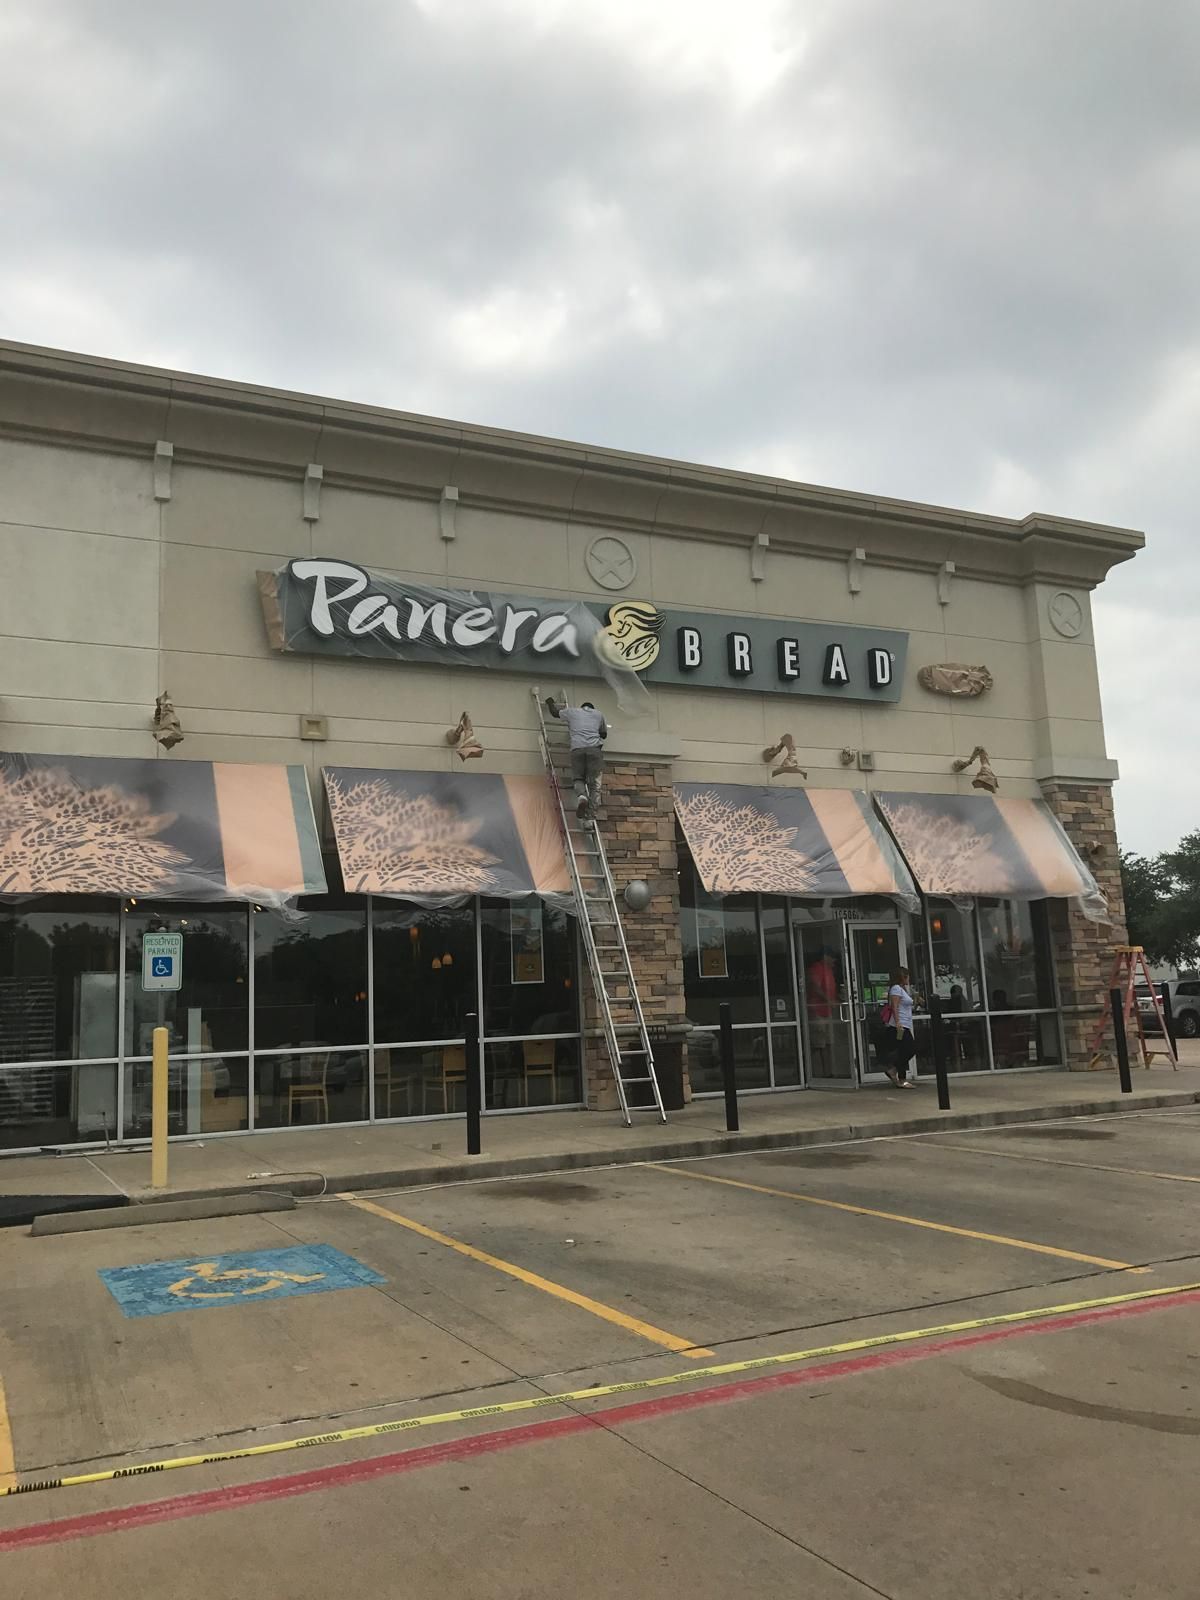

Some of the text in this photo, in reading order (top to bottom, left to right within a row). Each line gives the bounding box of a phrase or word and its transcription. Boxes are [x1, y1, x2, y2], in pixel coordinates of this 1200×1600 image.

[290, 558, 892, 689] Panera BREAD
[145, 938, 179, 946] RESERVED
